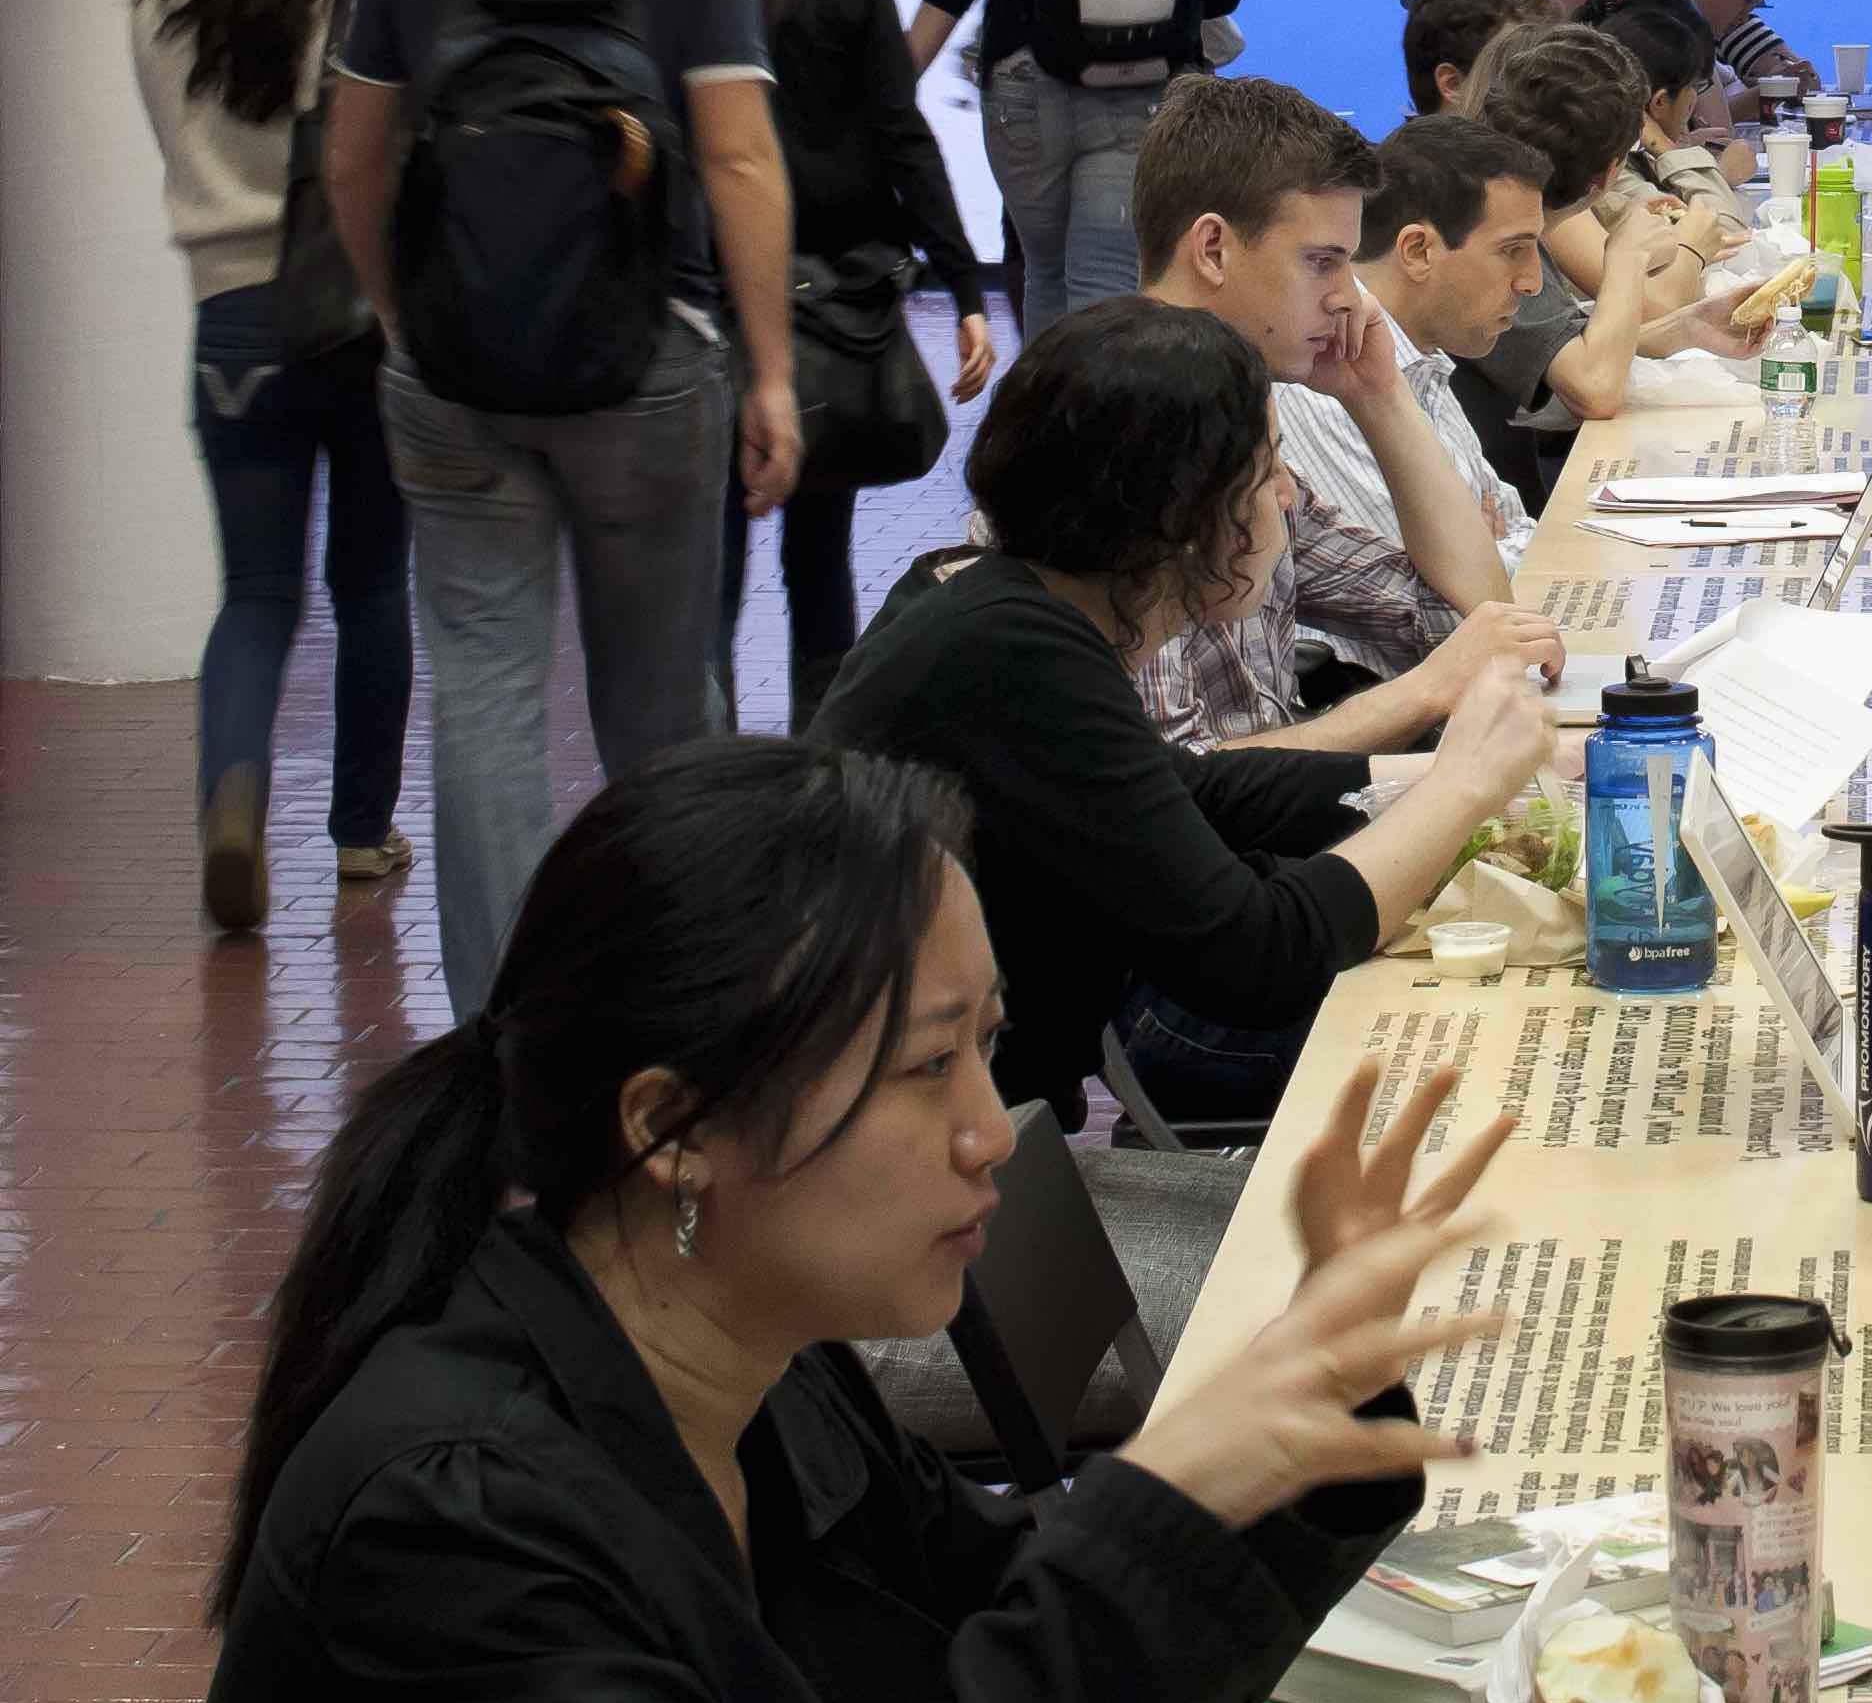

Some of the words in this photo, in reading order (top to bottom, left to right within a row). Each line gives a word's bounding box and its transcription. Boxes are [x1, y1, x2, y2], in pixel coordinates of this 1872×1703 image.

[1562, 1006, 1604, 1029] things,
[1618, 1005, 1649, 1021] HDC
[1711, 1012, 1741, 1024] the
[1860, 944, 1872, 1092] PROMONTORY
[1615, 1022, 1647, 1039] Loan
[1552, 1035, 1595, 1069] mortgage
[1612, 1040, 1635, 1054] was
[1698, 1025, 1737, 1060] aggregate
[1558, 1071, 1581, 1080] on
[1606, 1055, 1641, 1084] secured
[1694, 1061, 1736, 1094] principal
[1555, 1082, 1587, 1093] the
[1595, 1086, 1636, 1097] by,
[1498, 1103, 1525, 1117] an
[1589, 1098, 1625, 1125] among
[1699, 1095, 1730, 1125] amount
[1799, 1098, 1830, 1121] made
[1533, 1095, 1584, 1147] Partnership's
[1697, 1127, 1730, 1135] of
[1790, 1122, 1831, 1132] by
[1594, 1126, 1629, 1148] other
[1798, 1133, 1831, 1152] HDC
